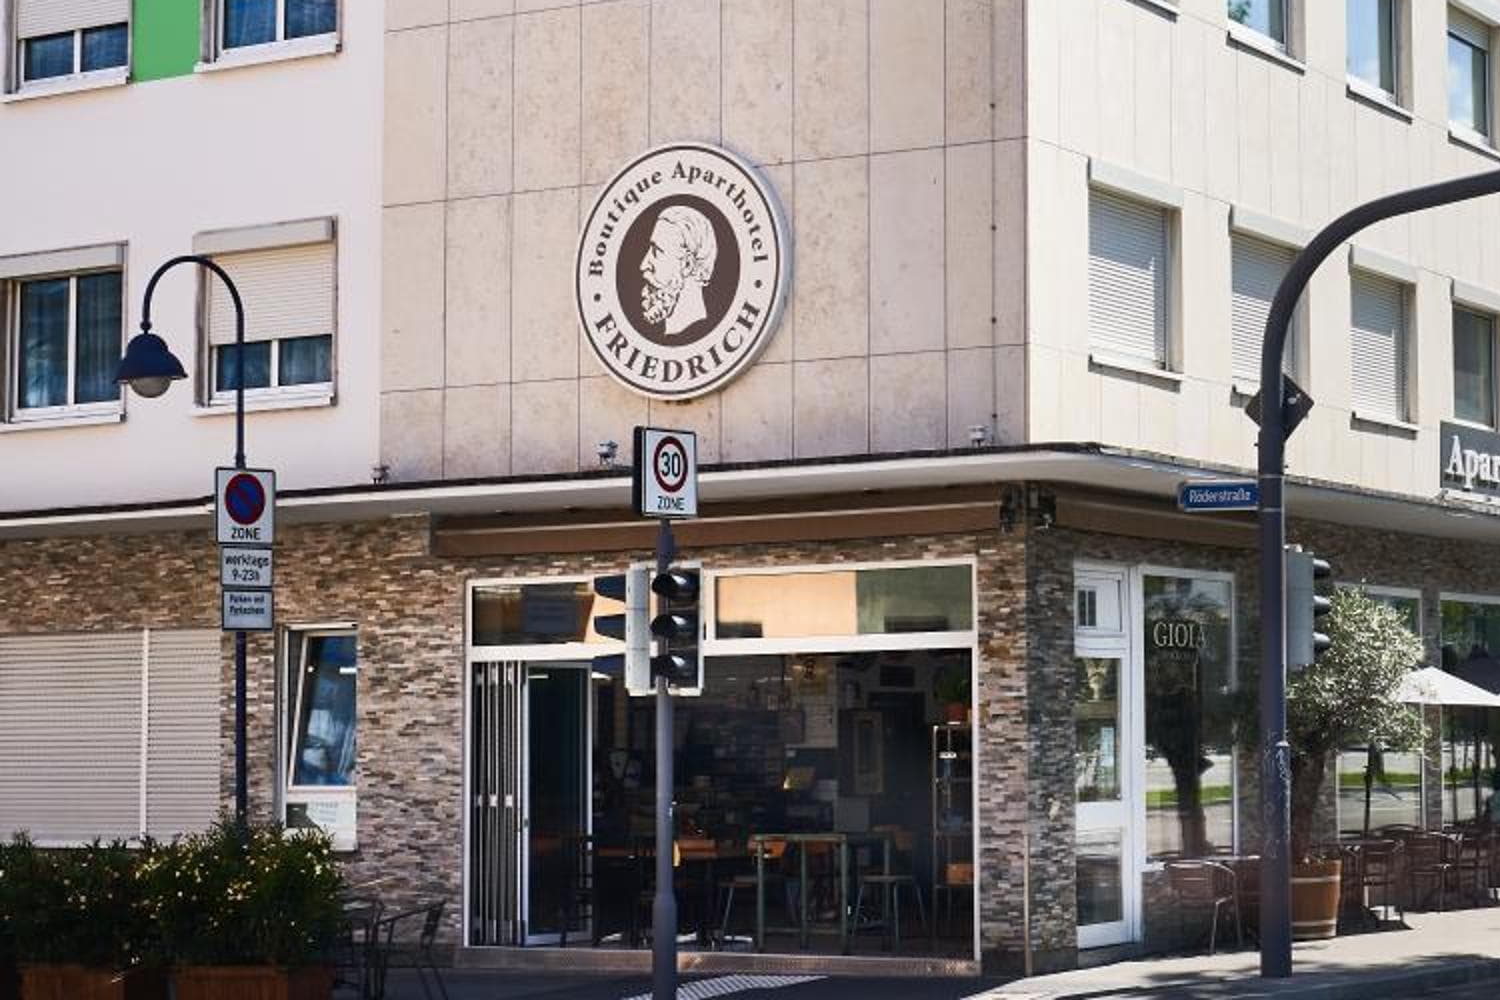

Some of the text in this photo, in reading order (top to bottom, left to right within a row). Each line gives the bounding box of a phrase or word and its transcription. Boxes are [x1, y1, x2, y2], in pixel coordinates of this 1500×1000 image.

[588, 160, 769, 277] Boutique Aparthotel
[595, 301, 761, 383] FRIEDRICH
[660, 451, 681, 478] 30
[657, 495, 685, 511] ZONE
[1188, 487, 1252, 503] Röderstraße
[231, 527, 260, 541] ZONE
